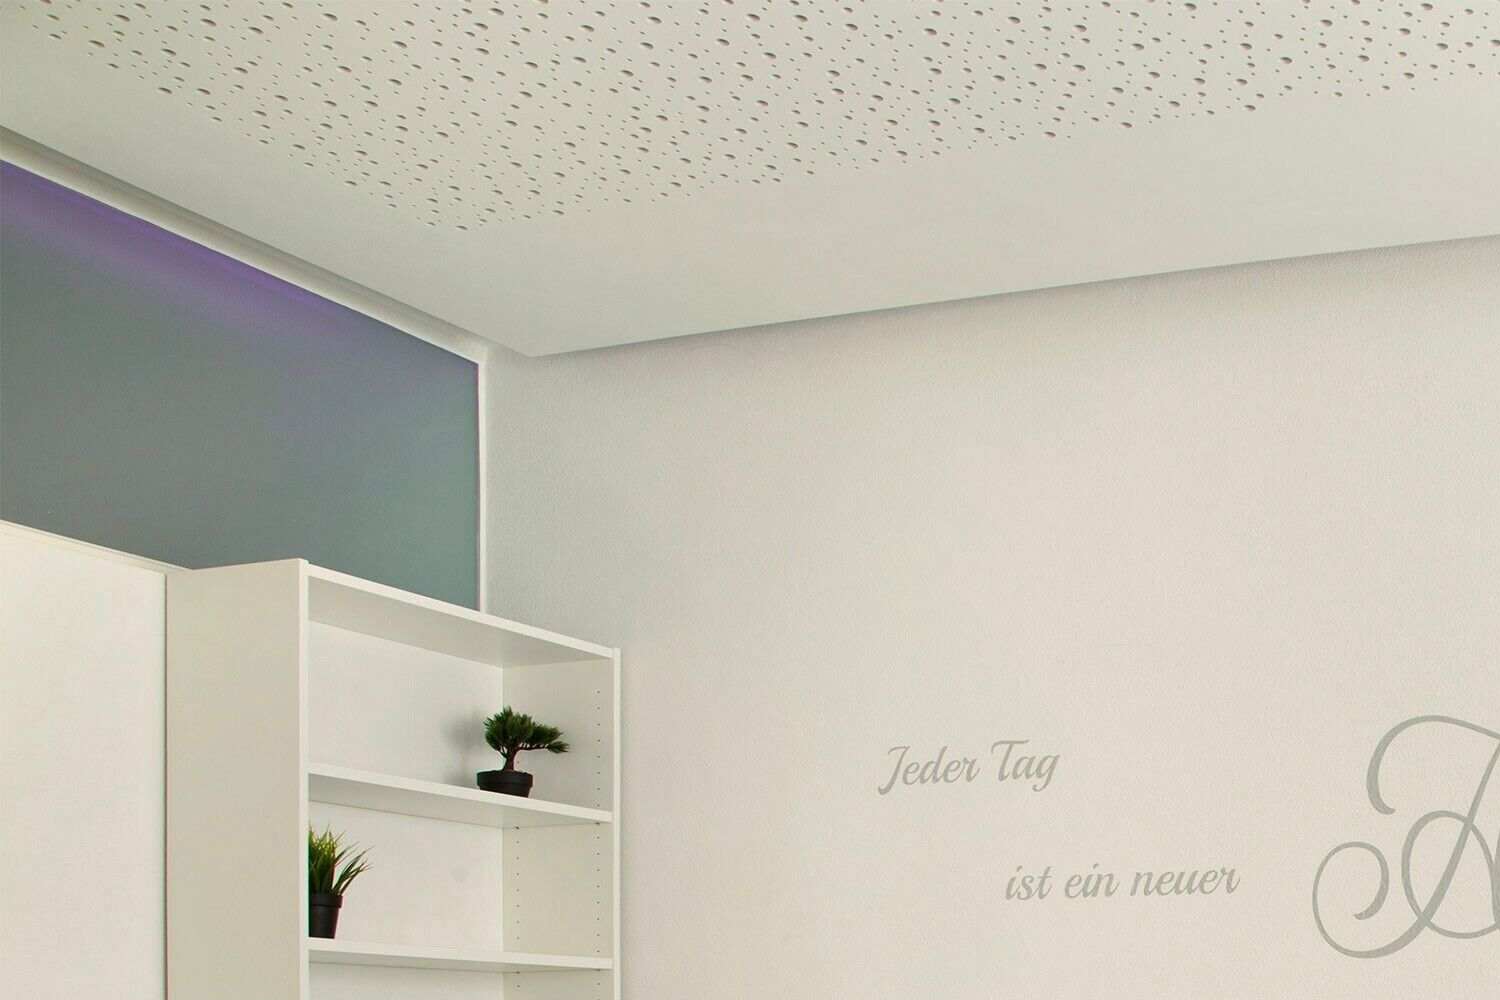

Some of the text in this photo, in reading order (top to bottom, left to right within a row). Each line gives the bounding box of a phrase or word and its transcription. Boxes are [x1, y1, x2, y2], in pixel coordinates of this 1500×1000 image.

[877, 739, 1061, 796] Jeder Tag
[1004, 862, 1241, 900] ist ein neuer
